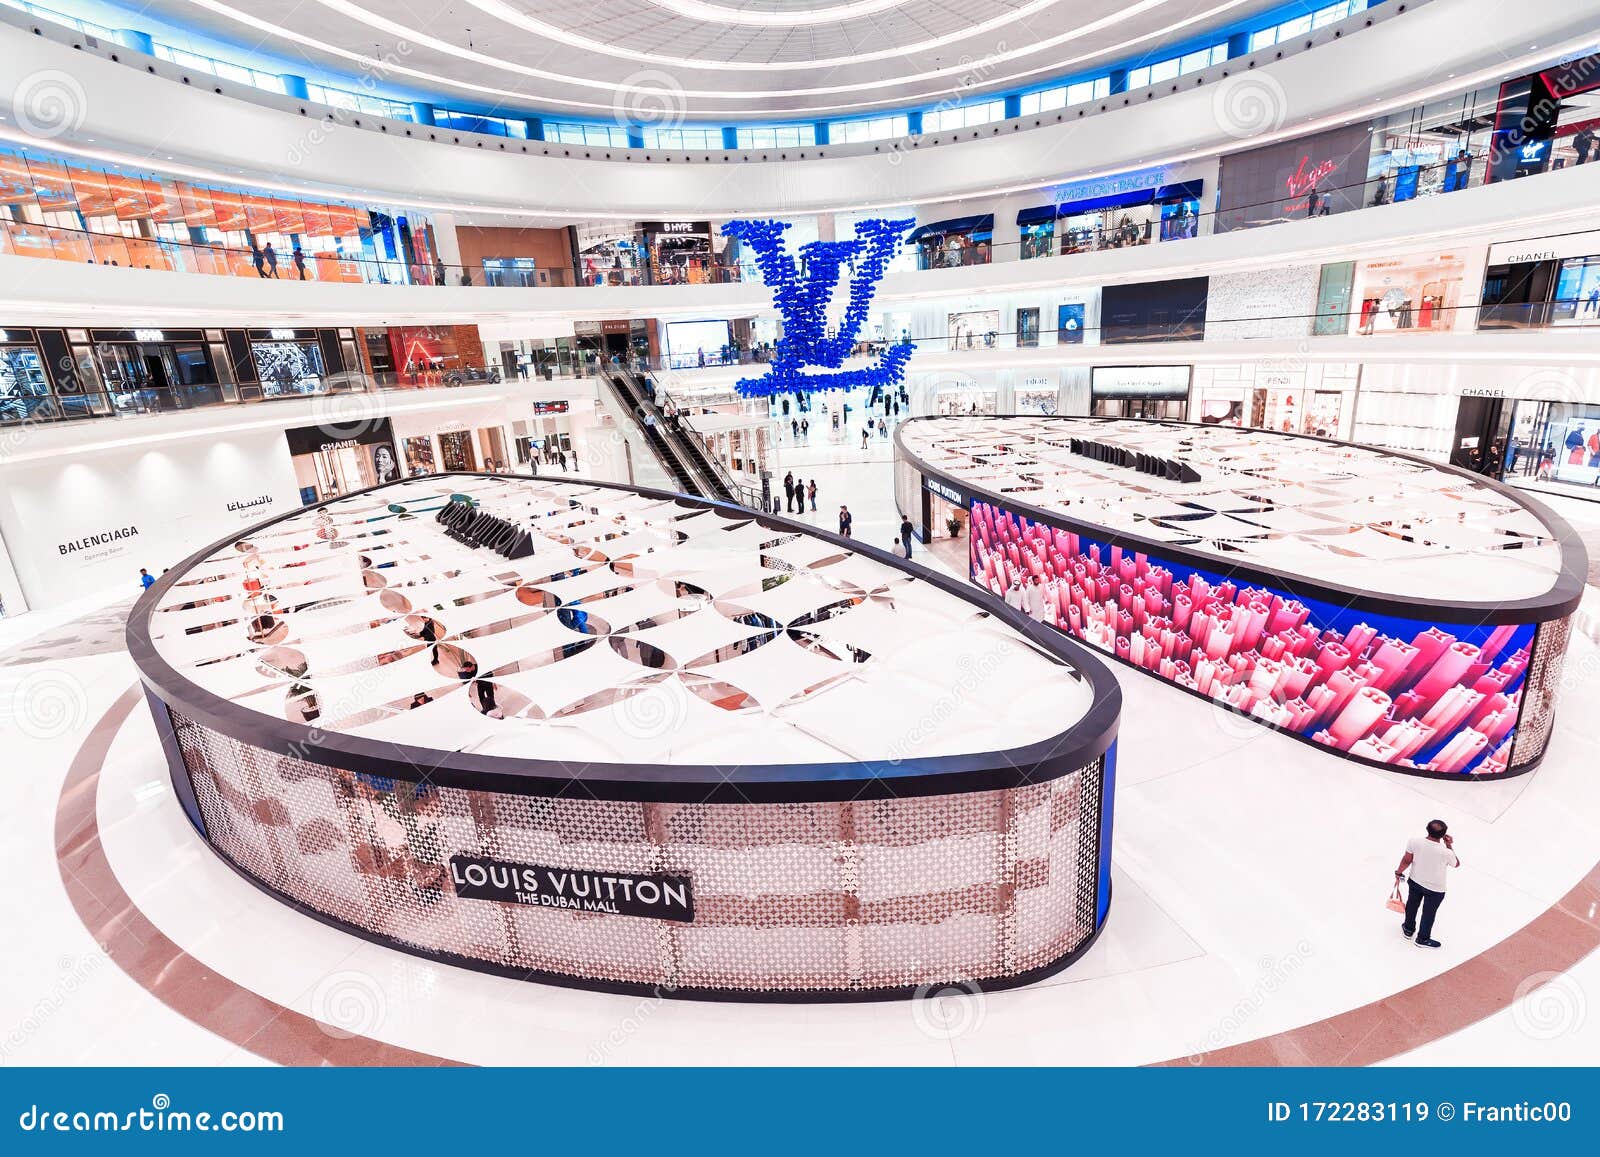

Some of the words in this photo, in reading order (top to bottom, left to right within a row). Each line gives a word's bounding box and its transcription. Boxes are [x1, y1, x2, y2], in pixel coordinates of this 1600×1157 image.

[663, 222, 671, 232] B
[671, 222, 694, 232] HYPE
[1507, 251, 1558, 263] CHANEL
[1461, 388, 1506, 397] CHANEL
[320, 440, 360, 451] CHANEL
[58, 525, 139, 556] BALENCIAGA
[450, 862, 539, 892] LOUIS
[546, 871, 688, 909] VUITTON
[515, 891, 542, 905] THE
[541, 893, 582, 909] DUBAI
[583, 899, 620, 914] MALL
